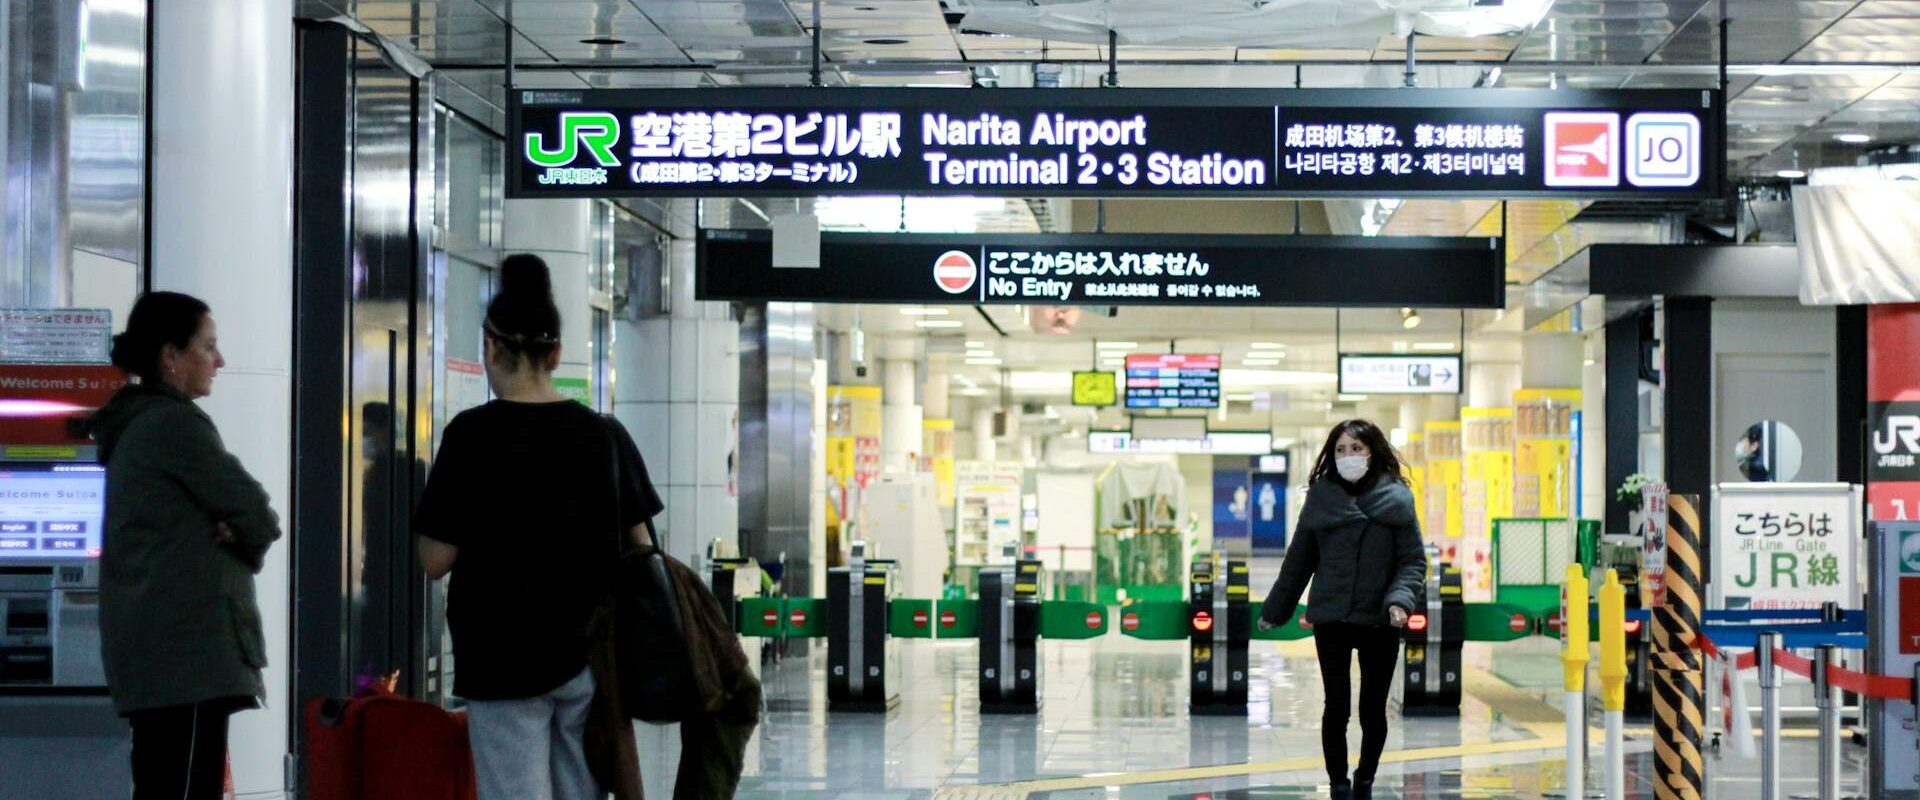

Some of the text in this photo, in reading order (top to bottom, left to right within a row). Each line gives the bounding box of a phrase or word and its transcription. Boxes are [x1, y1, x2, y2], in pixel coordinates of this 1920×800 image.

[526, 112, 621, 167] JR
[631, 112, 901, 158] 空港第2ビル駅
[923, 113, 1147, 153] Narita Airport
[1642, 137, 1683, 163] JO
[539, 168, 608, 184] JR東日本
[923, 152, 1068, 185] Terminal
[1147, 152, 1266, 185] Station
[1286, 153, 1375, 175] 나리타공항
[989, 252, 1209, 276] ここからは入れません
[989, 278, 1072, 300] No Entry
[0, 377, 74, 389] Welcome
[1878, 454, 1915, 467] JR東日本
[1735, 512, 1833, 537] こちらは
[1739, 539, 1827, 551] JR Line Gate
